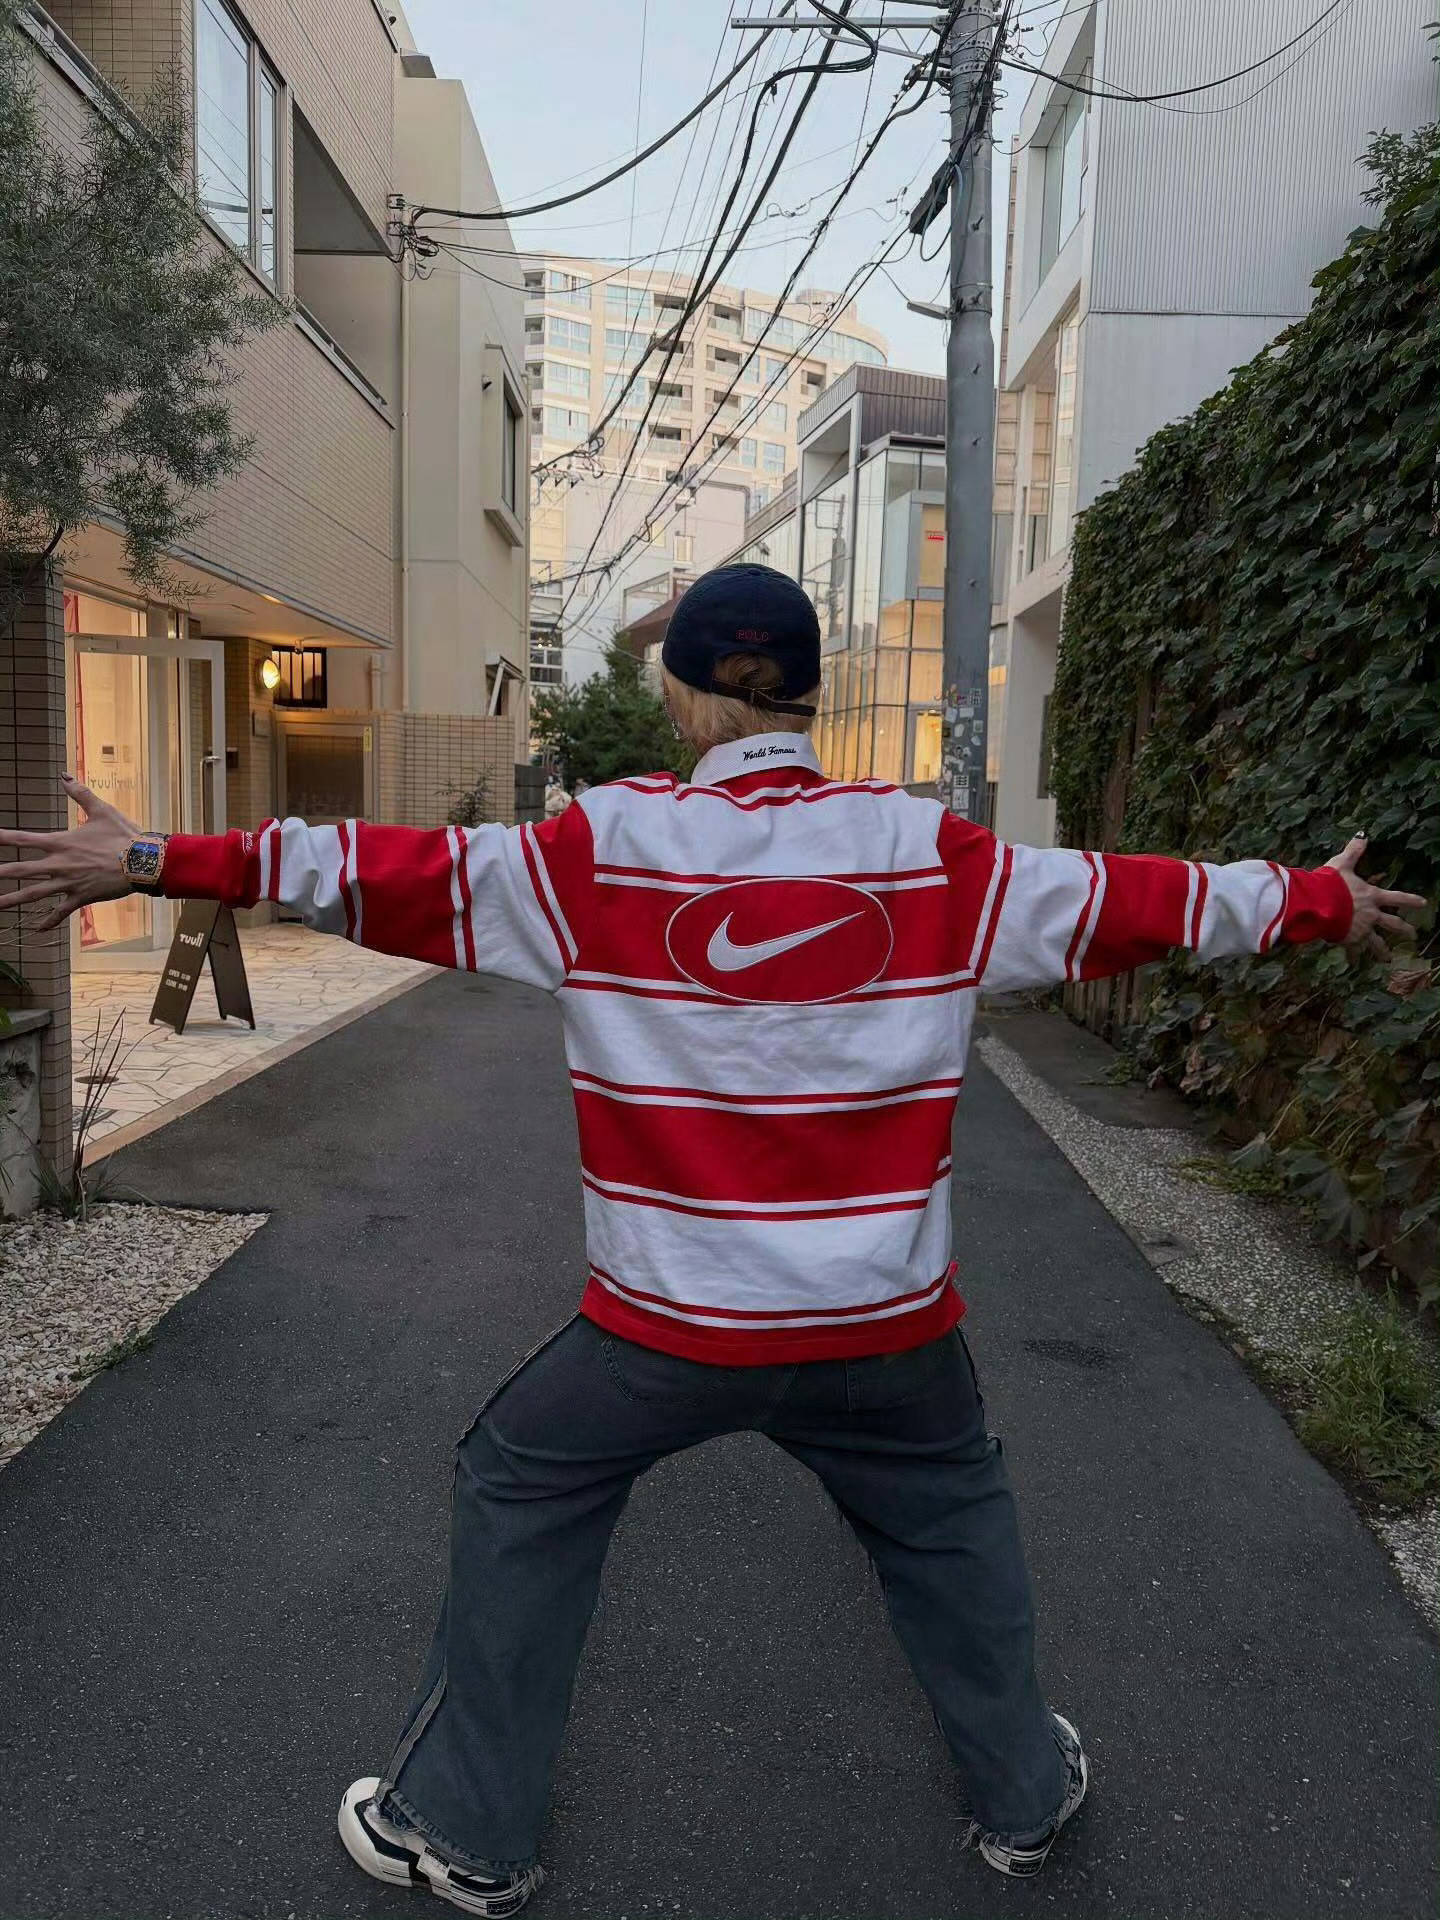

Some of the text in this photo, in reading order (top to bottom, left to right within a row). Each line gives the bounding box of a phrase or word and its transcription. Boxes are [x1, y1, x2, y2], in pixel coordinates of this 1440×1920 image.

[743, 745, 796, 761] World Famous
[180, 932, 204, 947] ruuli
